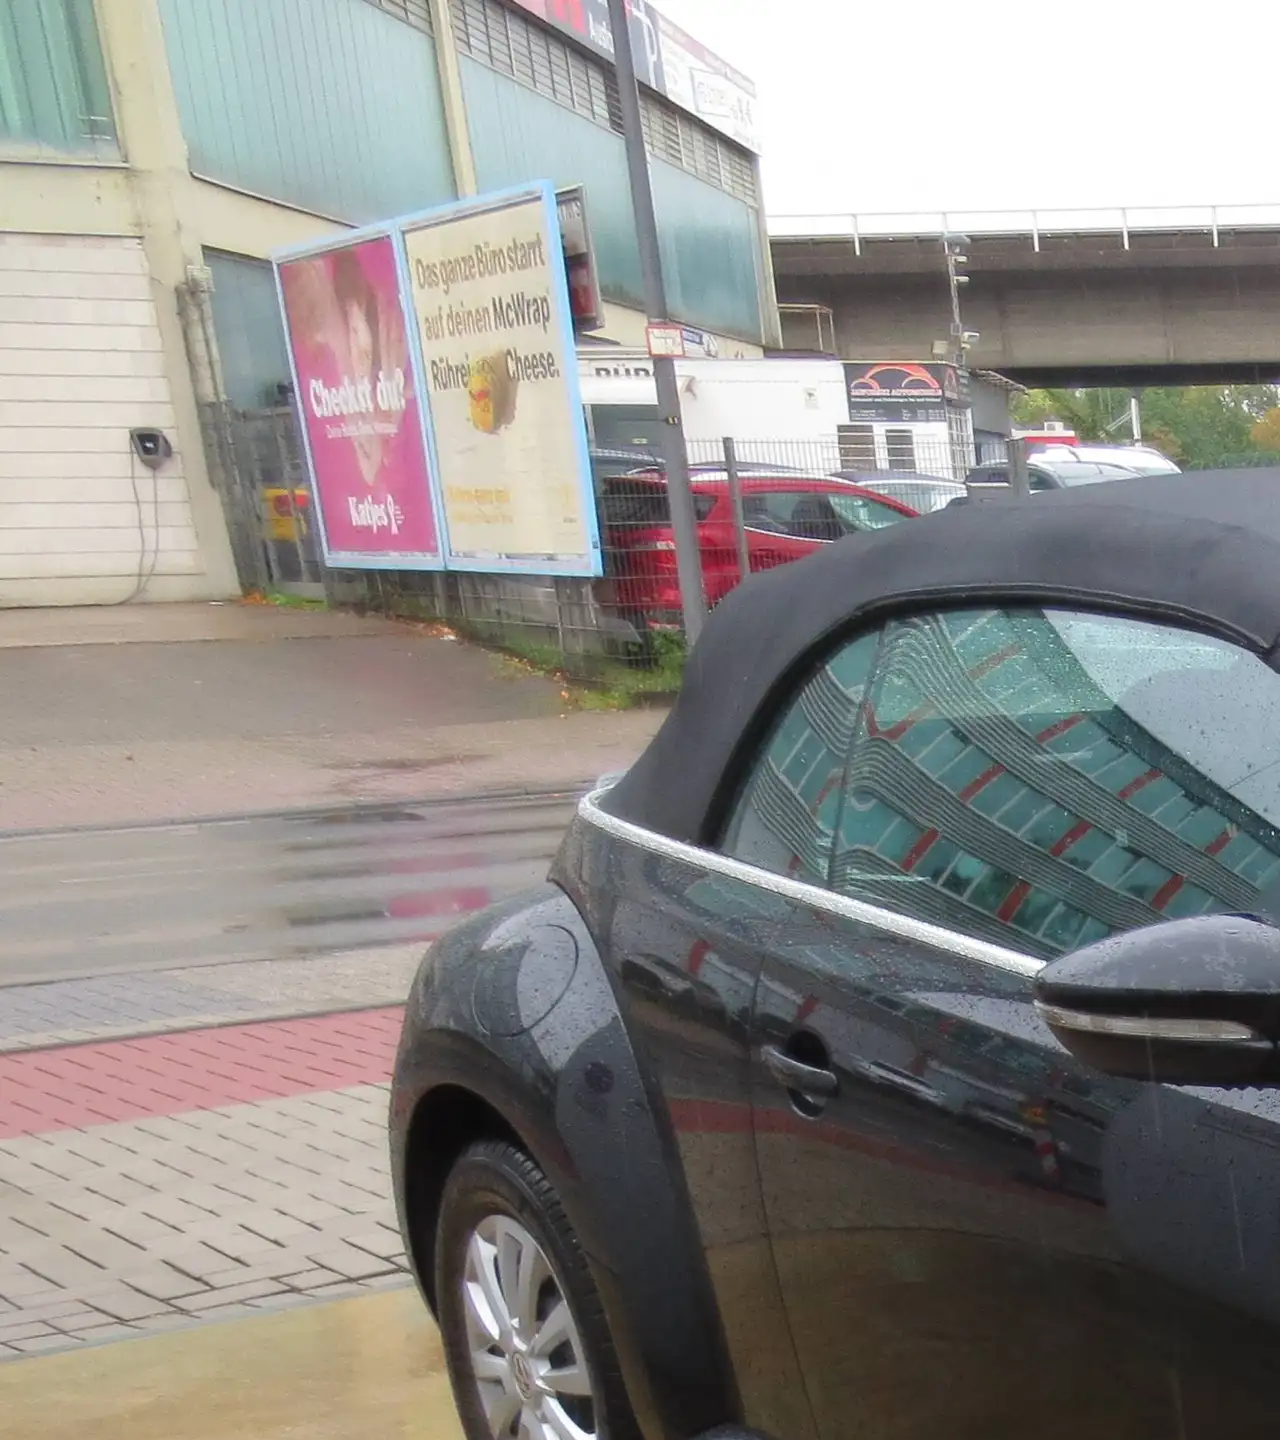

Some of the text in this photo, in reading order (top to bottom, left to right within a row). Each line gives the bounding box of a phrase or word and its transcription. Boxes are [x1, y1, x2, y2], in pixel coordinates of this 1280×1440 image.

[415, 232, 546, 295] Das ganze Büro starrt
[424, 304, 445, 341] auf
[446, 301, 493, 338] deinen
[505, 346, 560, 382] Cheese.
[376, 367, 406, 412] du?
[348, 494, 388, 534] Katjes
